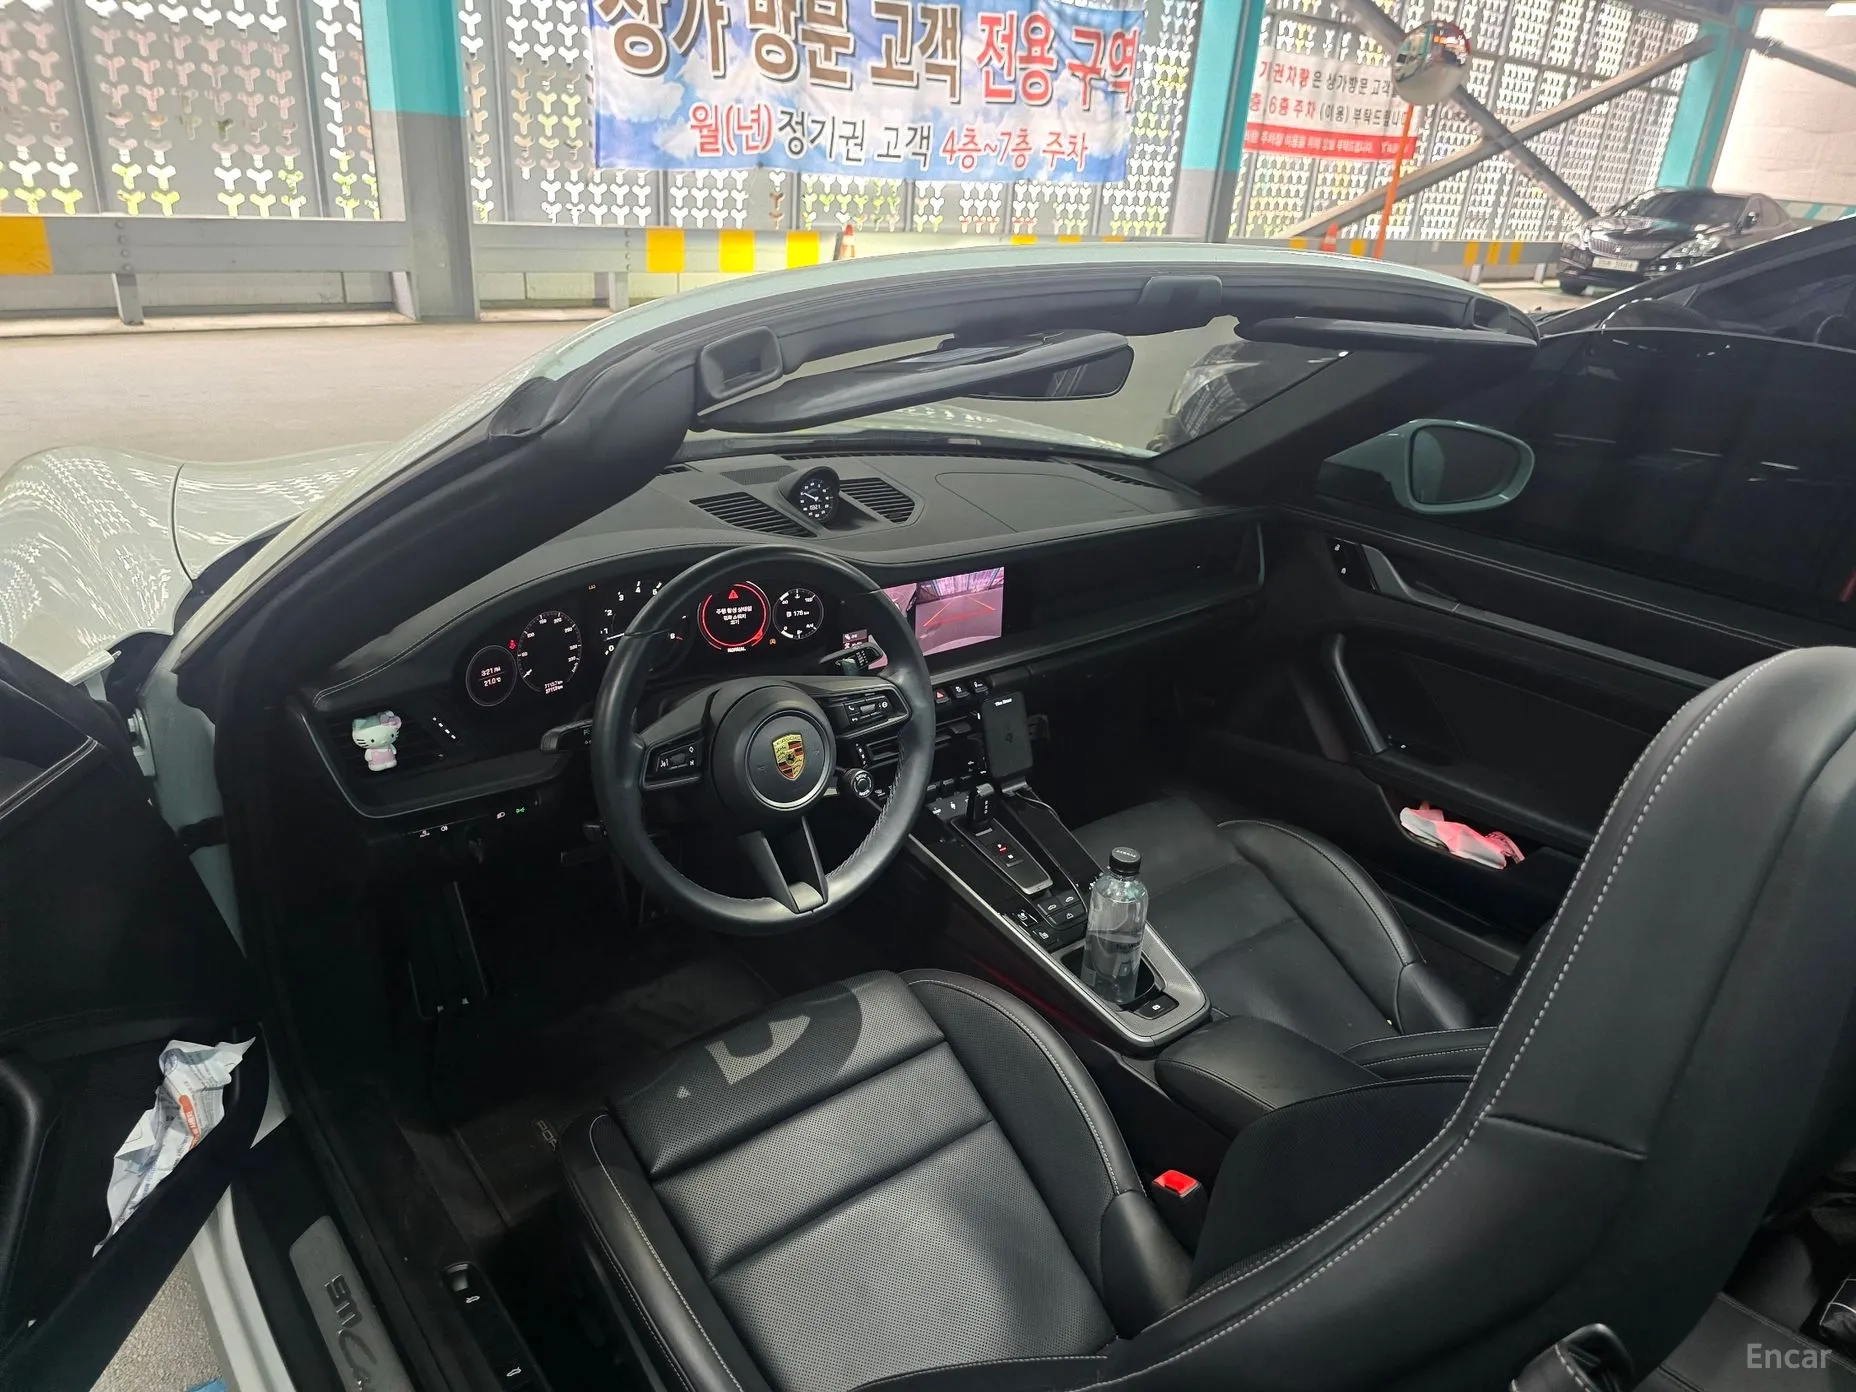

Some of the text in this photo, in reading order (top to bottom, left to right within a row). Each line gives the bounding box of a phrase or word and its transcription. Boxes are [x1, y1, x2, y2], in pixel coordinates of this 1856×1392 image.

[597, 0, 1140, 111] 상가 방문 고객 전용 구역
[1268, 95, 1290, 116] 6층
[1293, 99, 1316, 119] 주차
[1326, 73, 1368, 95] 상가방문
[690, 102, 1089, 170] 월(년) 정기권 고객 4층~7층 주차
